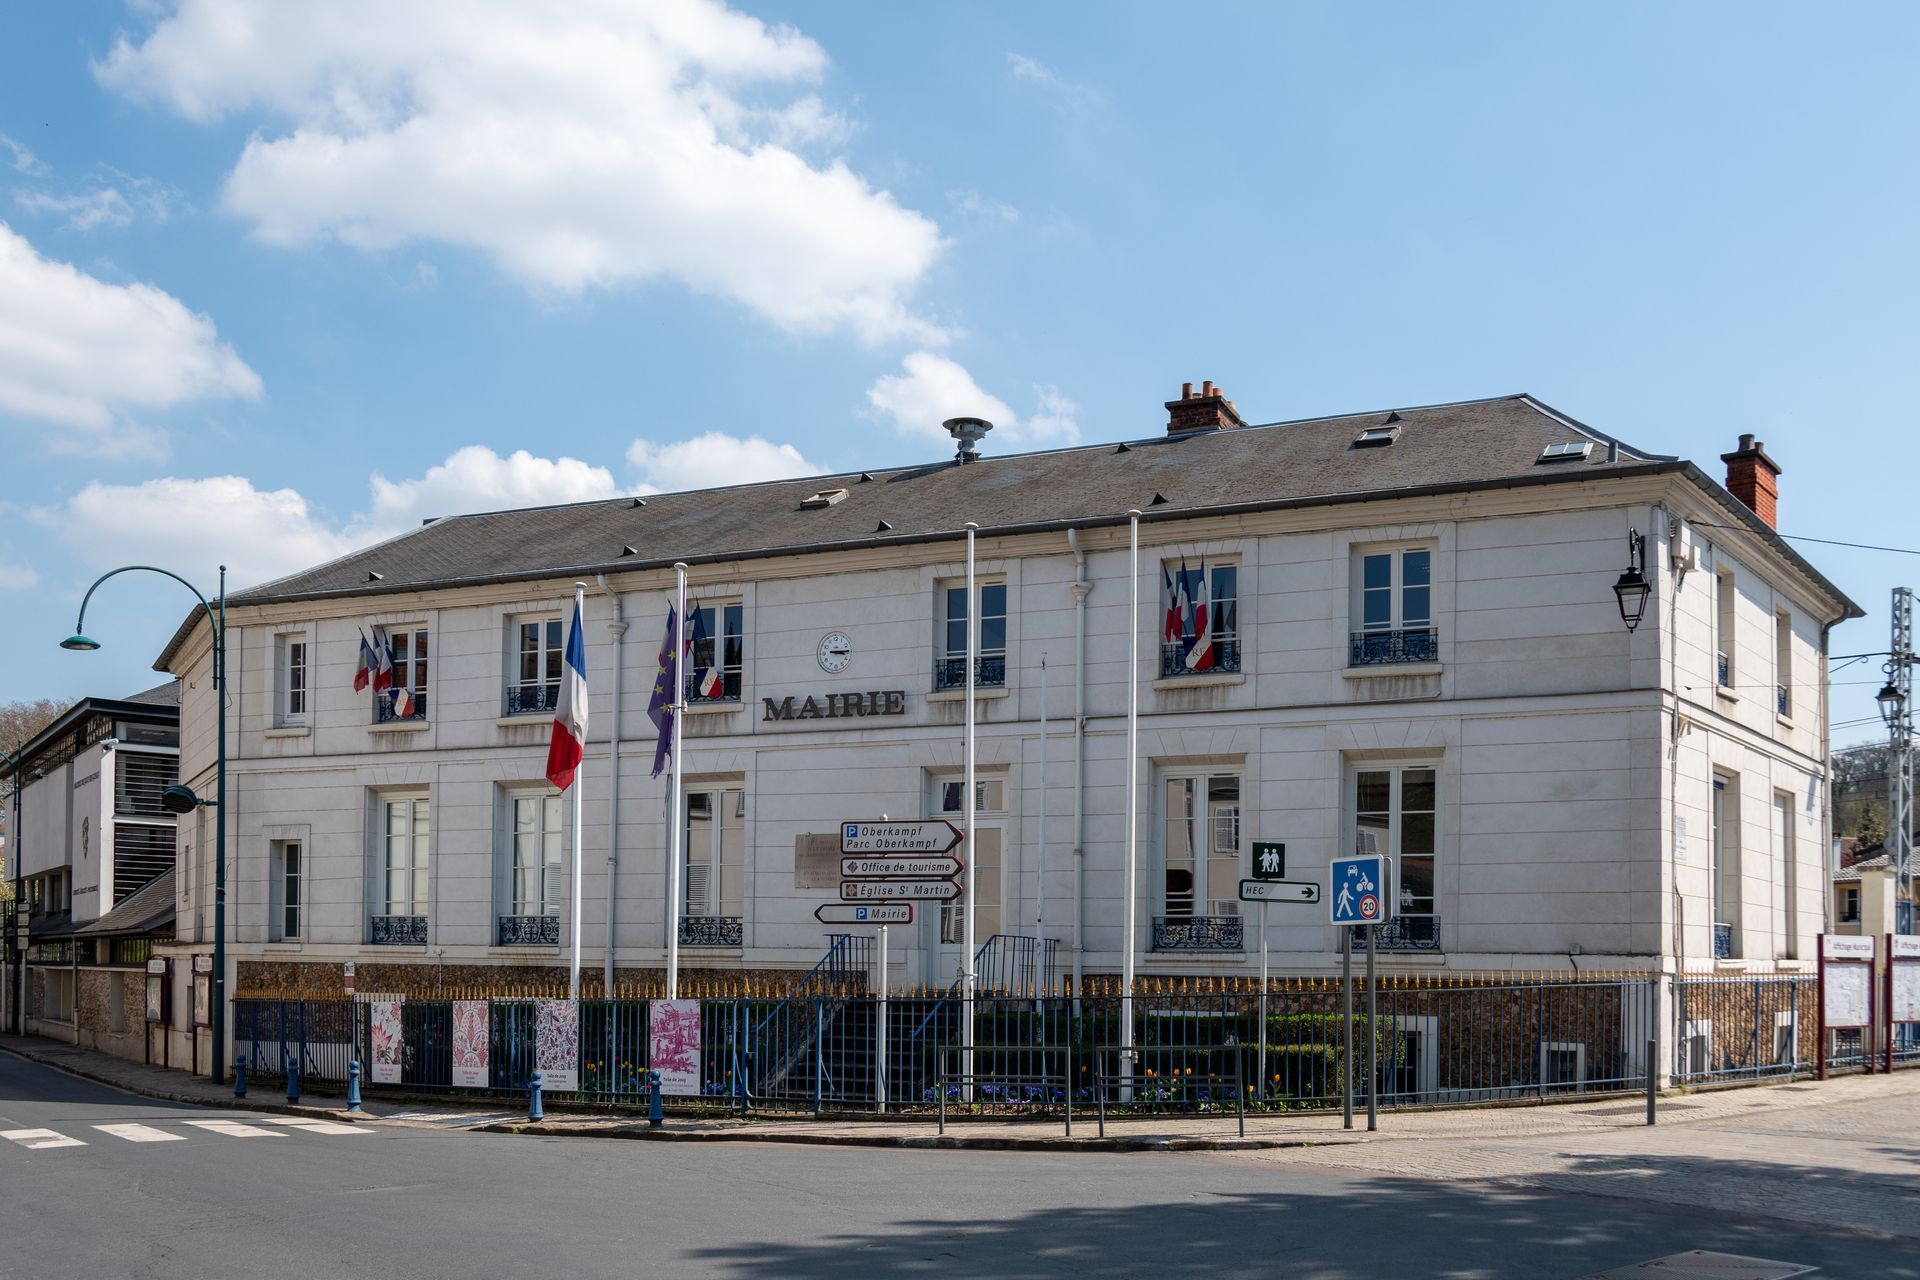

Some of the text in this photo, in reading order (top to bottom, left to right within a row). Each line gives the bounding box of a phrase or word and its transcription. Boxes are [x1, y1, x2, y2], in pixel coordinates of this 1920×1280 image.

[762, 690, 905, 721] MAIRIE
[848, 826, 922, 838] P Oberkampf
[846, 838, 937, 850] Parc Oberkampf
[861, 862, 951, 872] Office de tourisme
[860, 884, 893, 897] Église
[913, 885, 950, 895] Martin
[1245, 886, 1264, 895] HEC
[1363, 902, 1375, 912] 20
[857, 908, 907, 918] P Mairie
